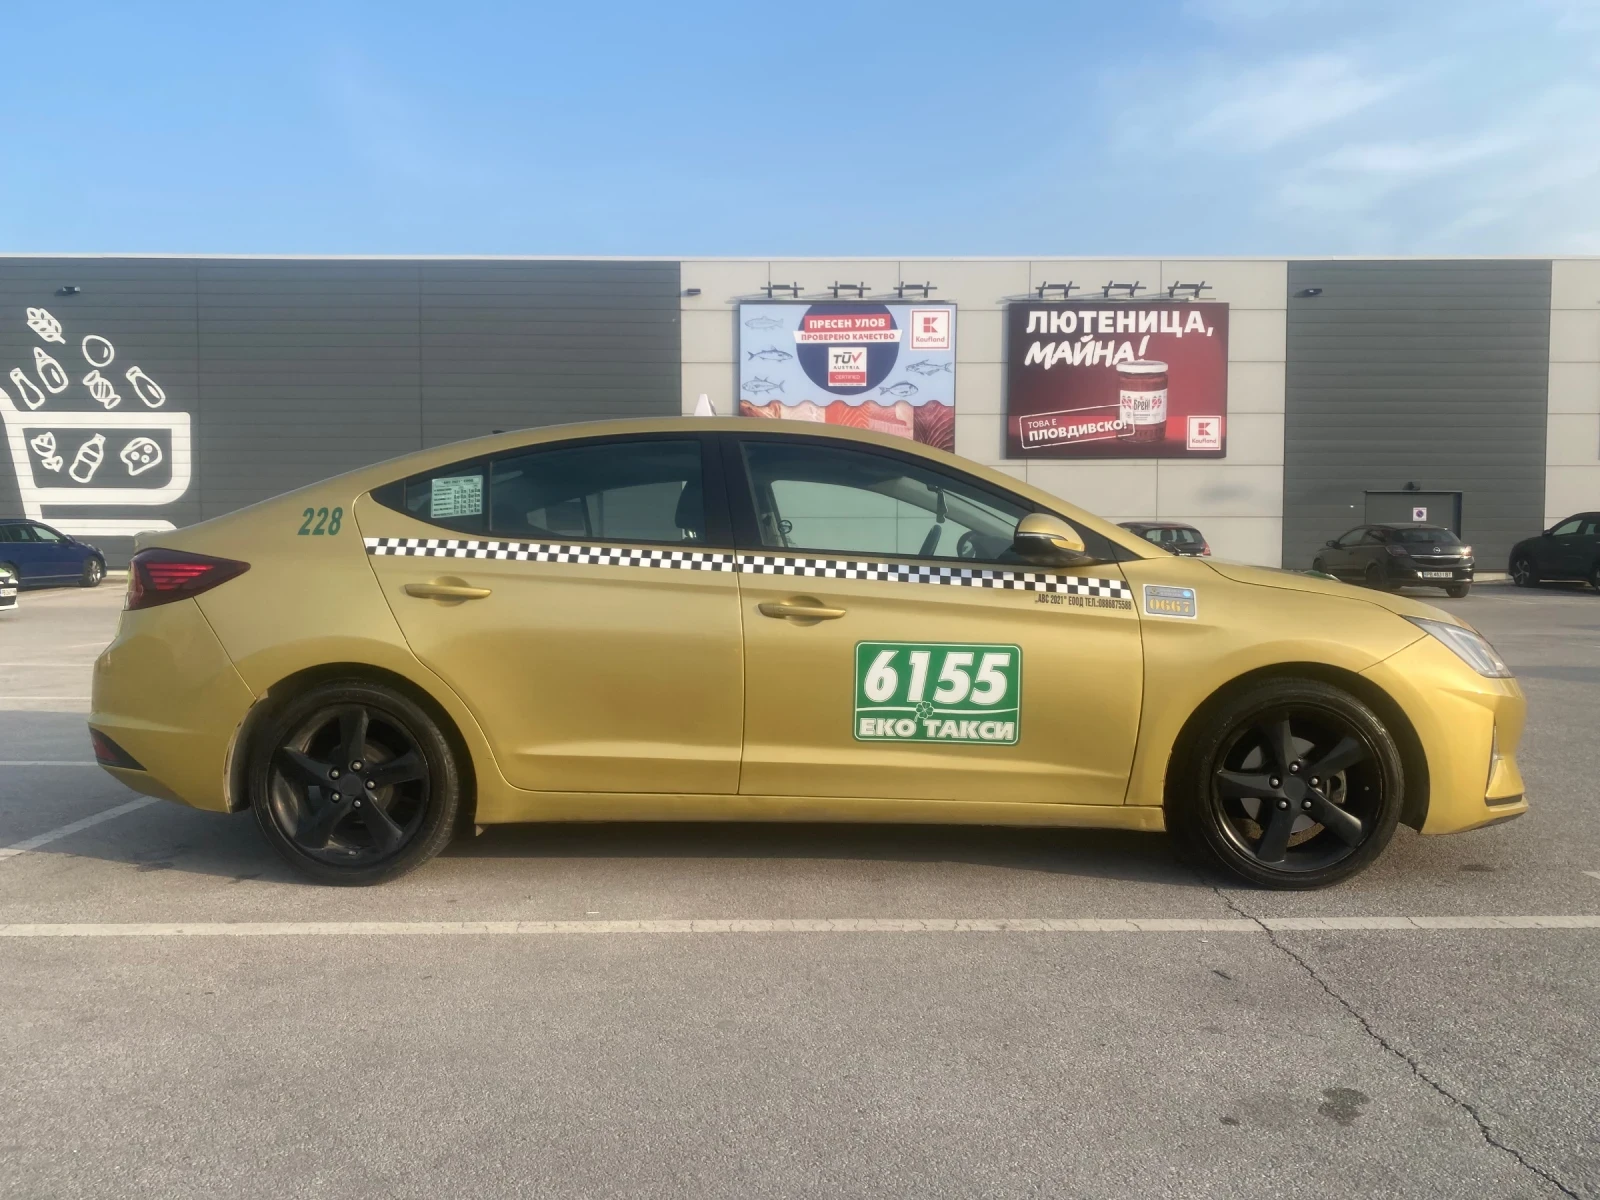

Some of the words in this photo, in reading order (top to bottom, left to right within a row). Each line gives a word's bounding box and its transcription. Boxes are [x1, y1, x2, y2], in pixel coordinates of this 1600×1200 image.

[809, 320, 852, 329] ПРЕСЕН
[854, 318, 886, 328] УЛОВ
[1026, 310, 1214, 337] ЛЮТЕНИЦА,
[801, 333, 851, 341] ПРОВЕРЕНО
[1024, 335, 1150, 370] МАЙНА!
[1028, 420, 1050, 429] ТОВА
[1051, 418, 1057, 426] Е
[1029, 420, 1128, 442] ПЛОВДИВСКО!
[298, 507, 343, 536] 228
[1068, 597, 1084, 608] ЕООД
[1149, 598, 1190, 613] 0667
[863, 650, 1011, 706] 6155
[858, 717, 917, 737] ЕКО
[922, 719, 1015, 740] ТАКСИ
